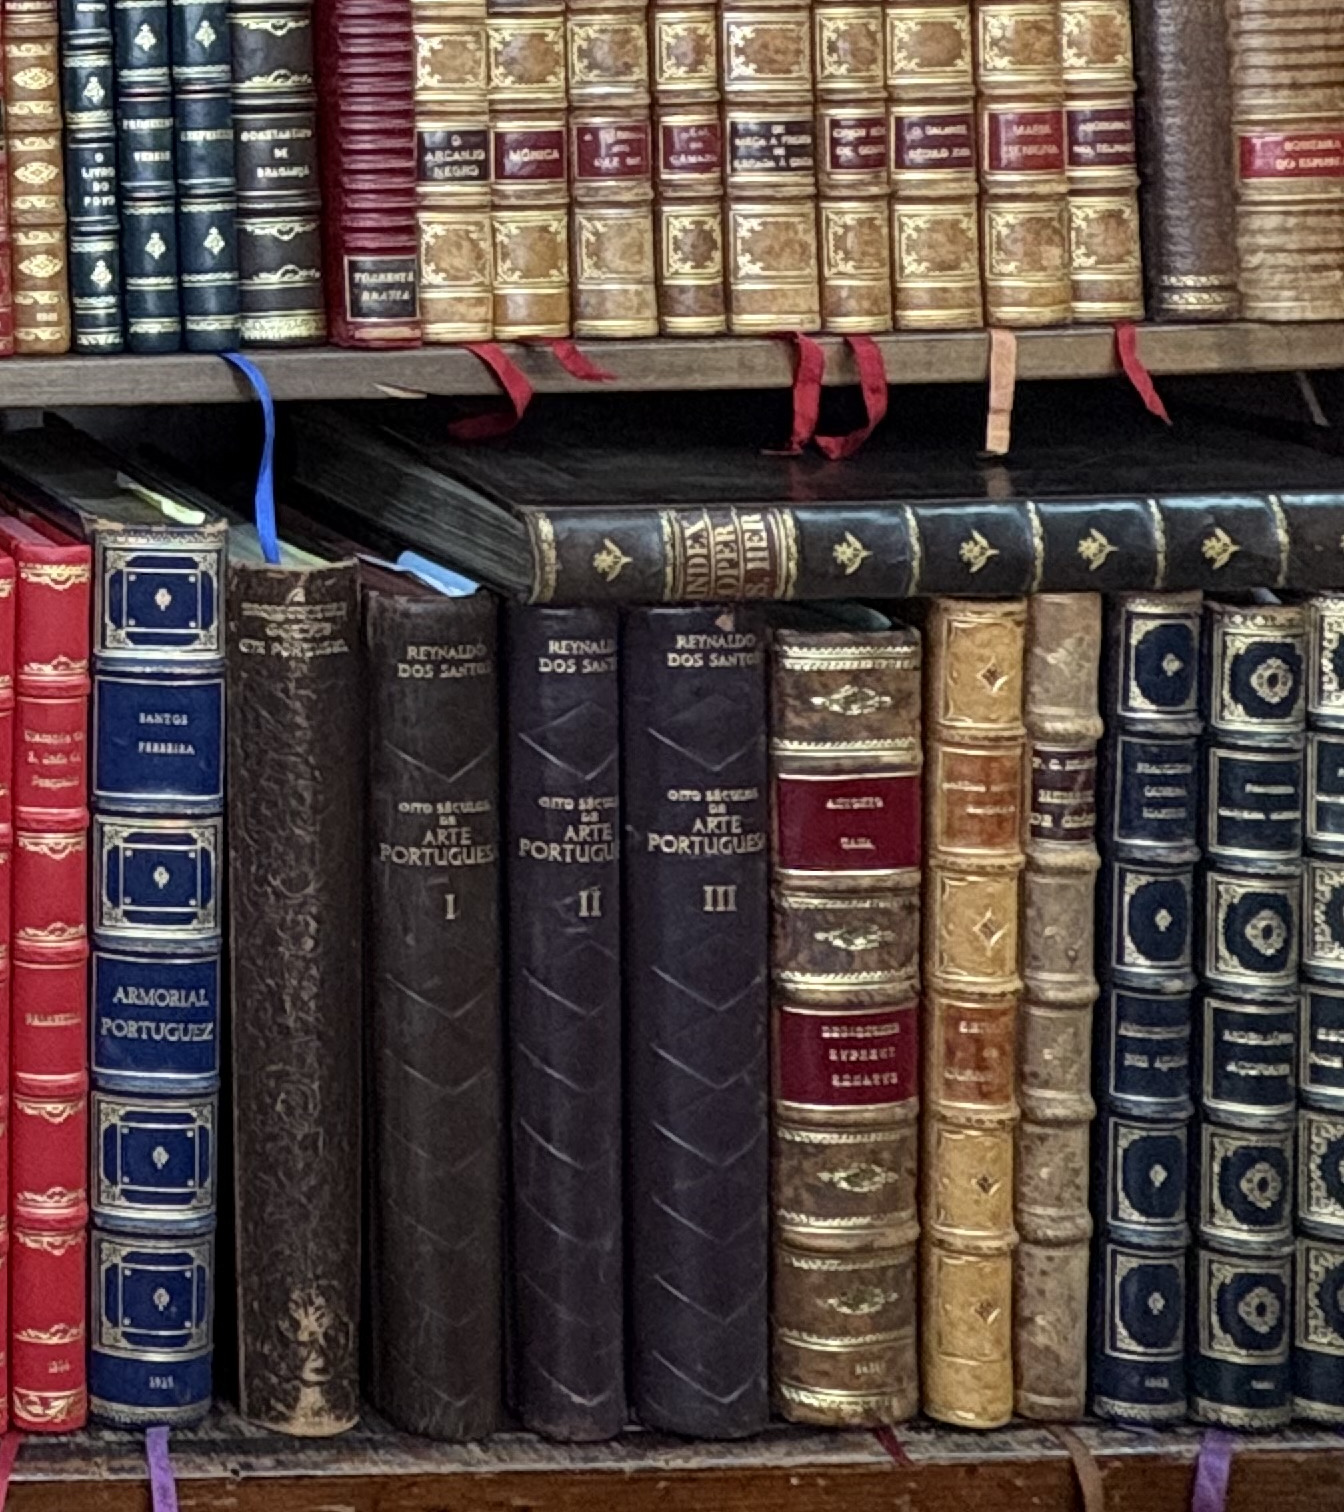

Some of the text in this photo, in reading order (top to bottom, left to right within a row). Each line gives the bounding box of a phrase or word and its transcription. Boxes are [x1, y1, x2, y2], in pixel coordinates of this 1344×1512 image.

[742, 514, 769, 570] HIER
[684, 519, 710, 599] INDEX
[407, 645, 487, 660] REYNALDO
[549, 640, 612, 655] REYNAL
[675, 634, 755, 650] REYNALDO
[397, 663, 433, 678] DOS
[539, 658, 616, 674] DOS SANT
[667, 652, 704, 668] DOS
[564, 825, 612, 842] ARTE
[692, 815, 742, 834] ARTE
[422, 827, 471, 846] ARTE
[647, 832, 764, 855] PORTUGUES
[380, 844, 494, 865] PORTUGUES
[519, 838, 613, 863] PORTUGU
[445, 894, 456, 919] I
[579, 890, 602, 917] II
[703, 885, 736, 912] III
[112, 986, 209, 1007] ARMORIAL
[100, 1018, 213, 1042] PORTUGUEZ
